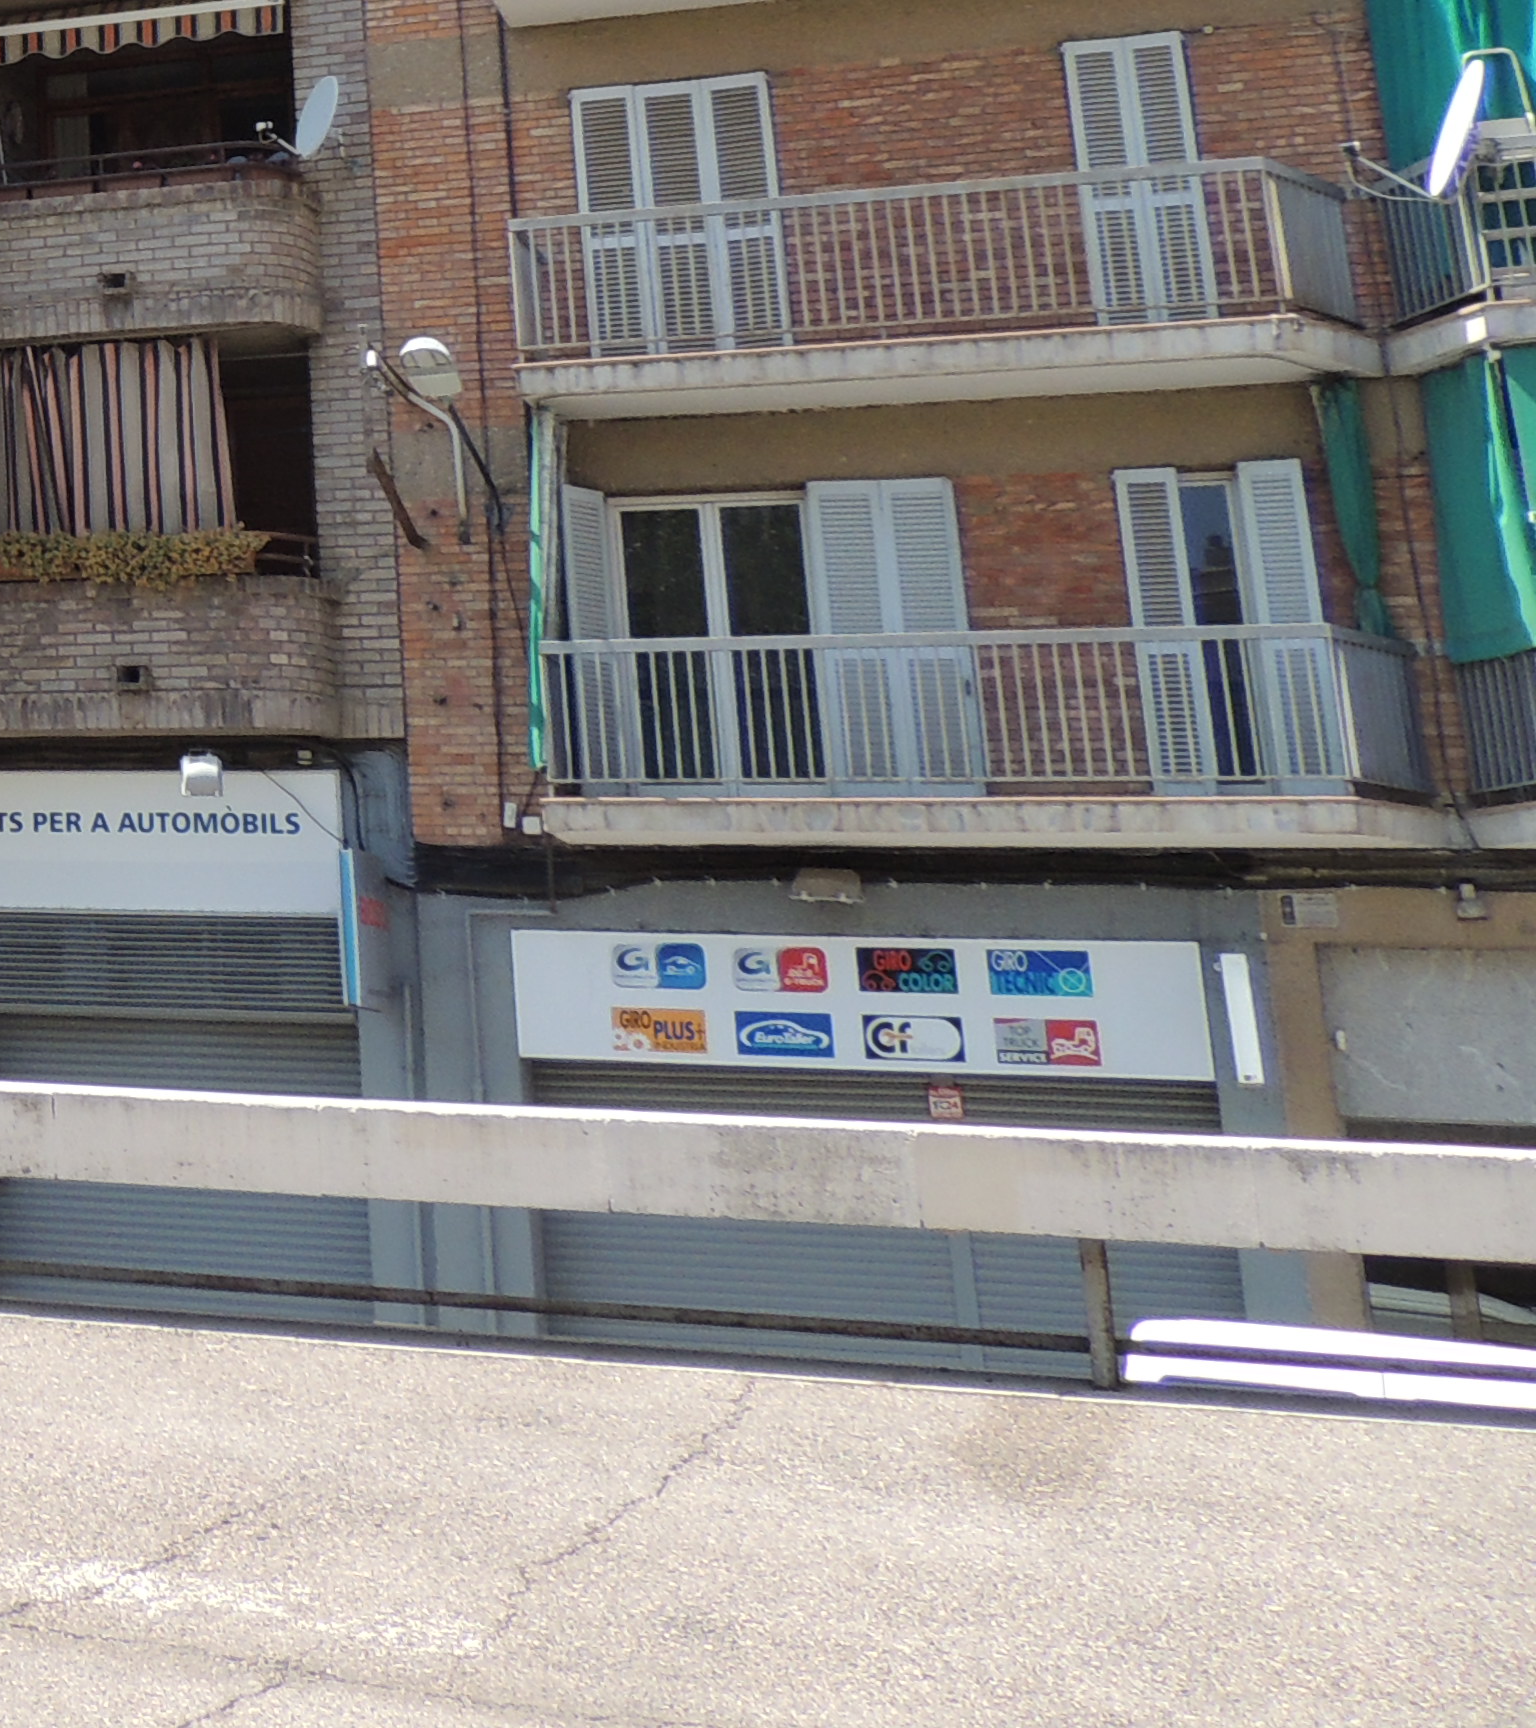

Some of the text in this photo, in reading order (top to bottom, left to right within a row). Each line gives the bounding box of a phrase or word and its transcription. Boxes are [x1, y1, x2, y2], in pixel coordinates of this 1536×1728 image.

[32, 811, 82, 833] PER
[90, 812, 110, 833] A
[117, 805, 301, 835] AUTOMÒBILS
[873, 950, 913, 972] GIRO
[990, 950, 1028, 972] GIRO
[898, 972, 956, 993] COLOR
[619, 1009, 652, 1030] GIRO
[998, 1052, 1048, 1064] SERVICE
